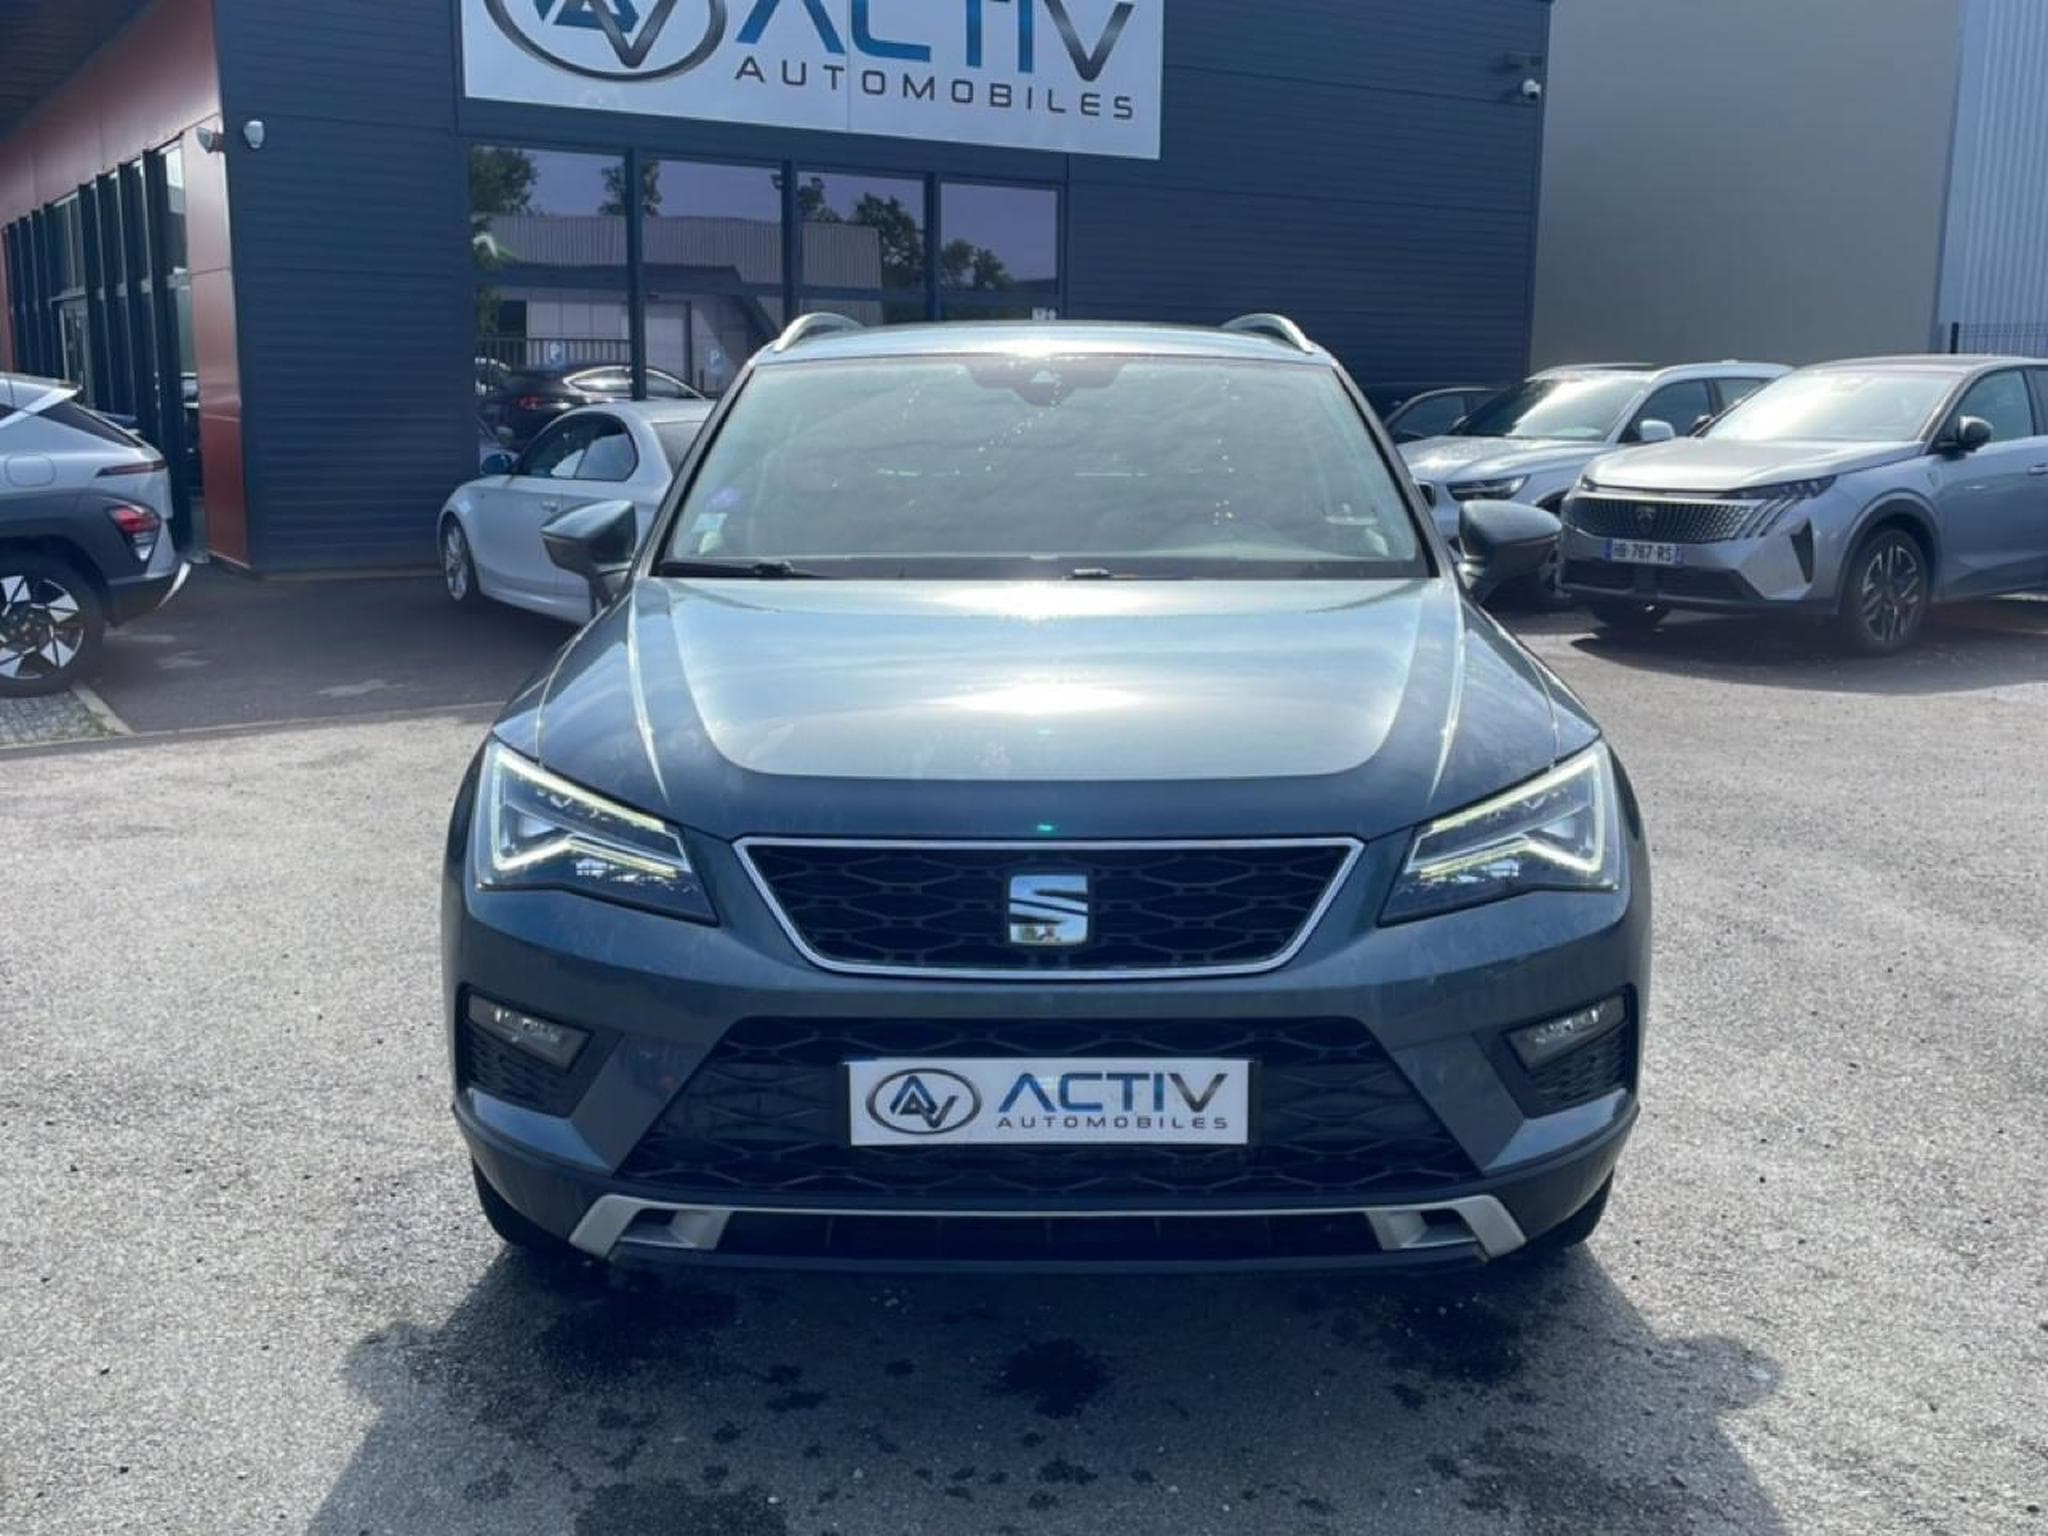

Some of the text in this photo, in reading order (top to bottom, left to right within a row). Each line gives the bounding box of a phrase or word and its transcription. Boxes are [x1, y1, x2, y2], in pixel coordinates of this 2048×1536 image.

[735, 56, 1134, 120] AUTOMOBILES
[998, 1072, 1229, 1113] ACTIV
[998, 1115, 1228, 1130] AUTOMOBILES
